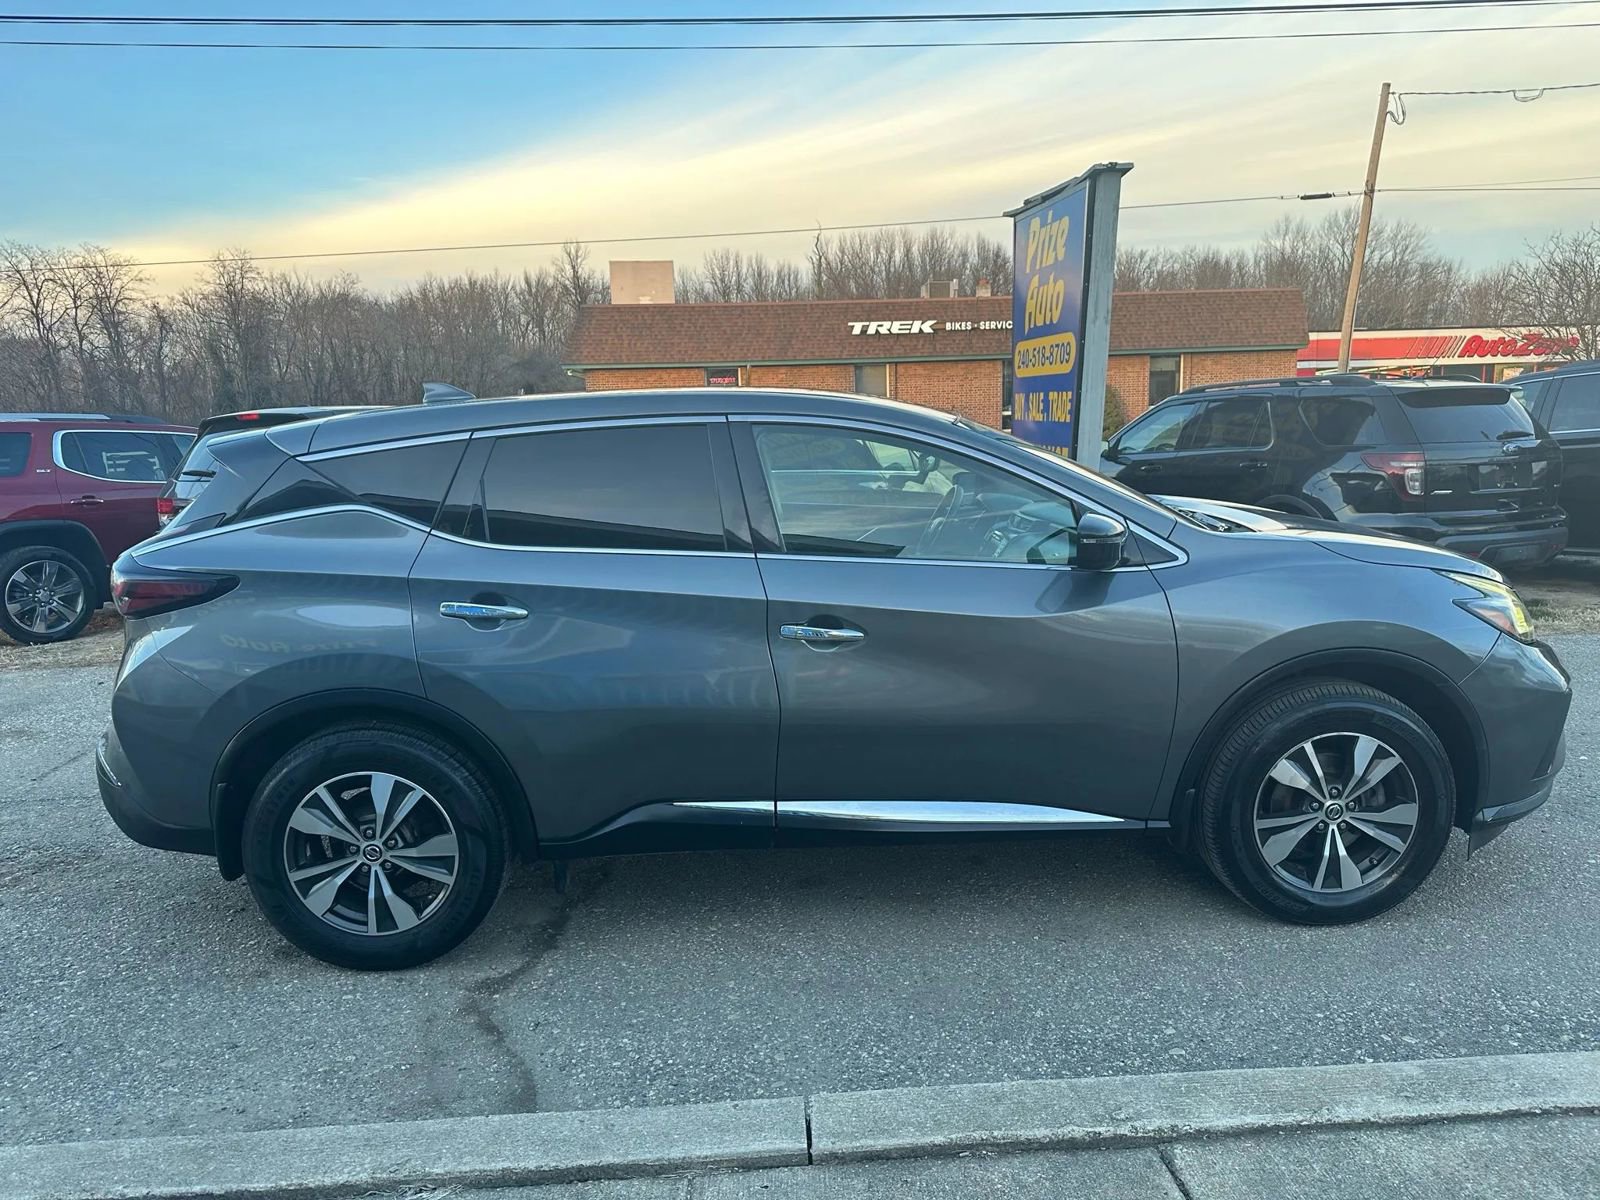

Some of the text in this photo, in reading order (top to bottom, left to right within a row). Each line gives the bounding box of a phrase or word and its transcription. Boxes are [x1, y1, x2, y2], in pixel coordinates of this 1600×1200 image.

[1025, 209, 1070, 274] Prize
[1024, 271, 1065, 336] Auto
[848, 320, 1013, 335] TREK BIKES SERVIC
[1017, 341, 1072, 370] 240-518-8709
[1028, 392, 1044, 422] SALE
[1048, 391, 1073, 423] TRADE
